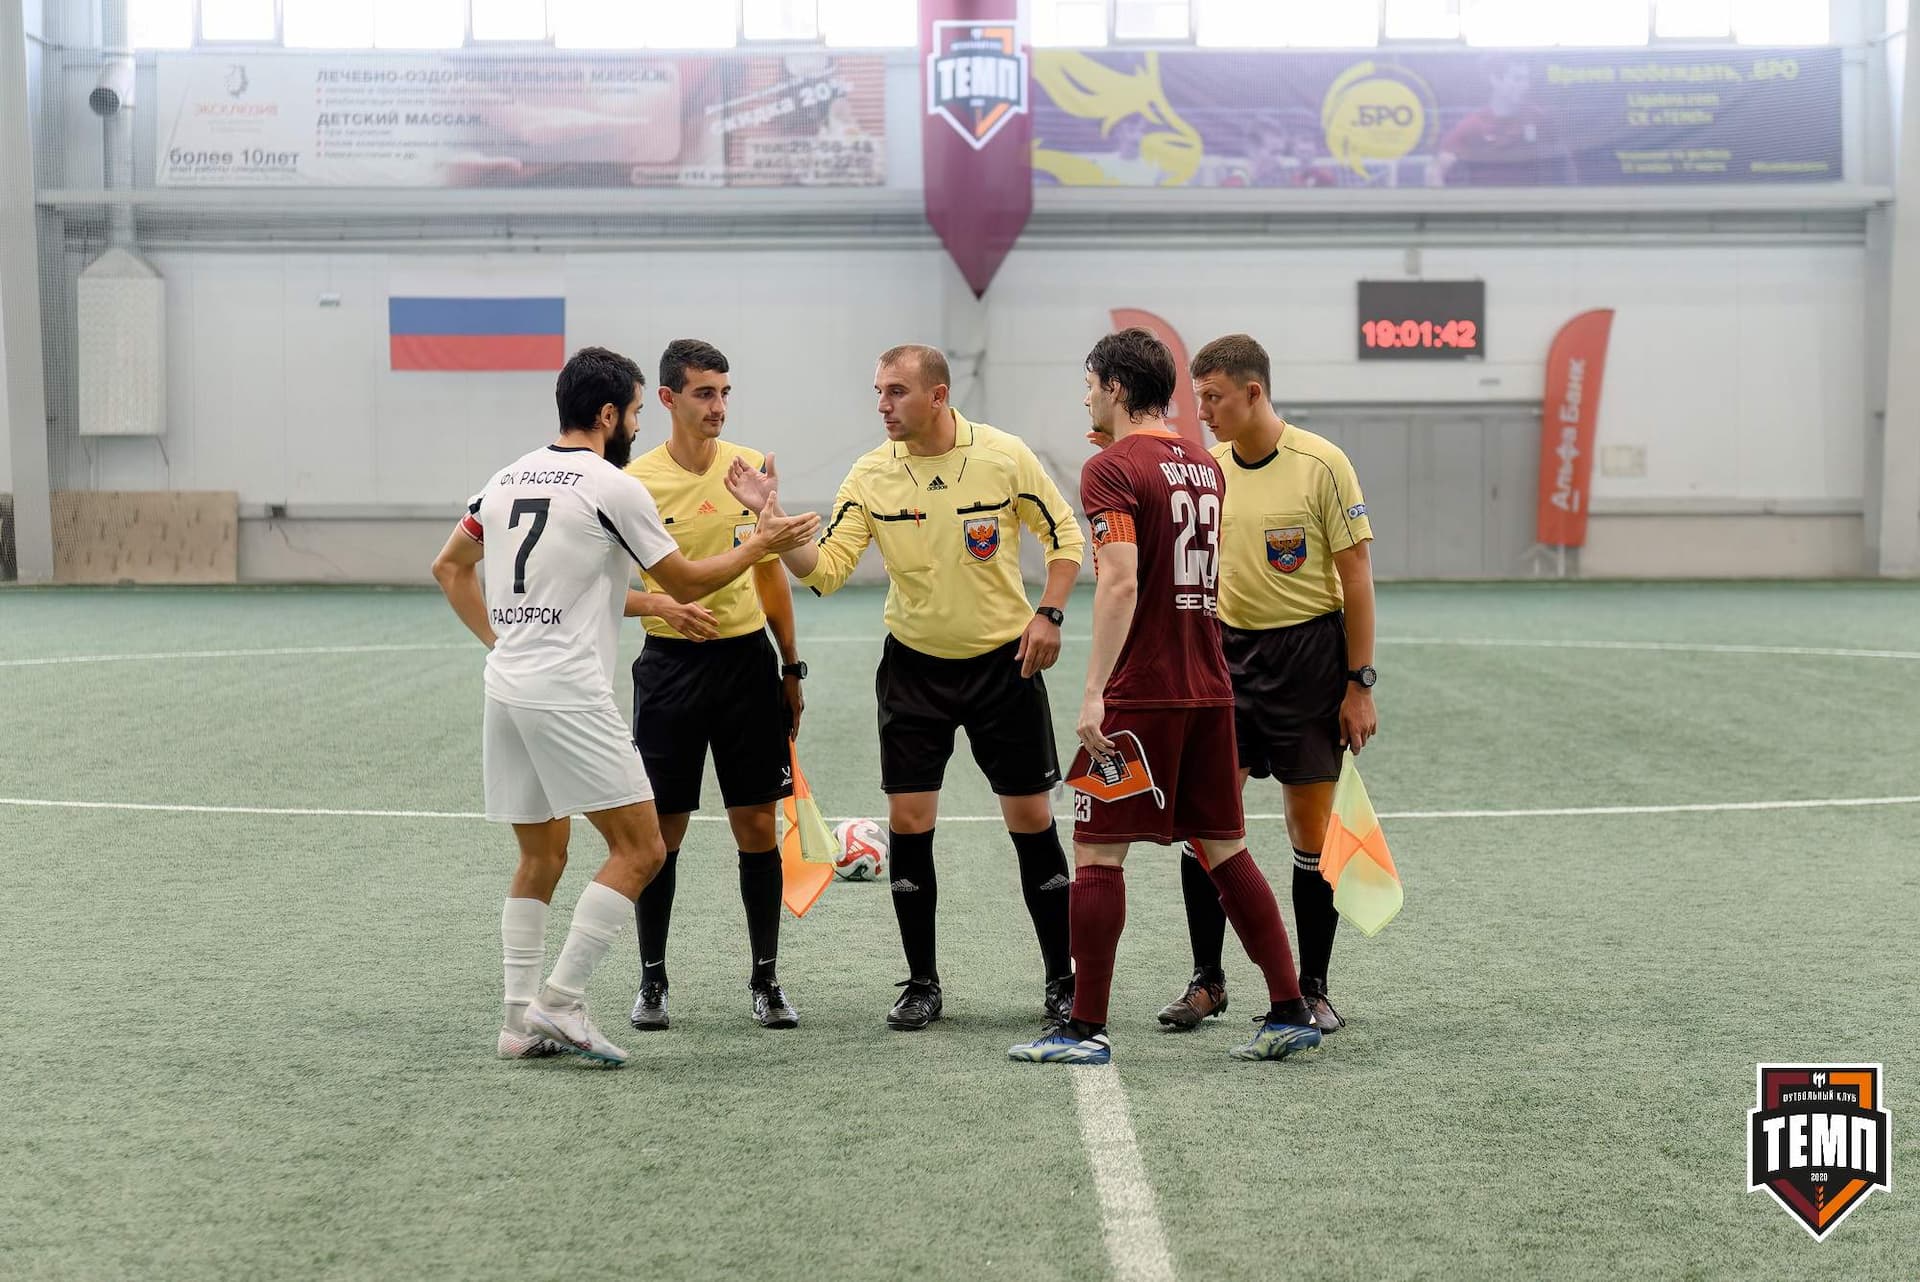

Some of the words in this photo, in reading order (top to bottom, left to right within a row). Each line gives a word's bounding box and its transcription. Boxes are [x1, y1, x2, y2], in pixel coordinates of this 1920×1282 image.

[936, 55, 1018, 101] ТЕМП
[316, 111, 399, 128] ДЕТСКИЙ
[1350, 104, 1414, 127] .БРО
[169, 146, 234, 165] более
[240, 148, 300, 165] 10лет
[519, 471, 584, 486] РАССВЕТ
[1159, 461, 1218, 492] ВОРОНА
[508, 498, 551, 594] 7
[1170, 490, 1219, 589] 23
[490, 606, 563, 625] РАСОЯРСК
[1075, 794, 1092, 822] 23
